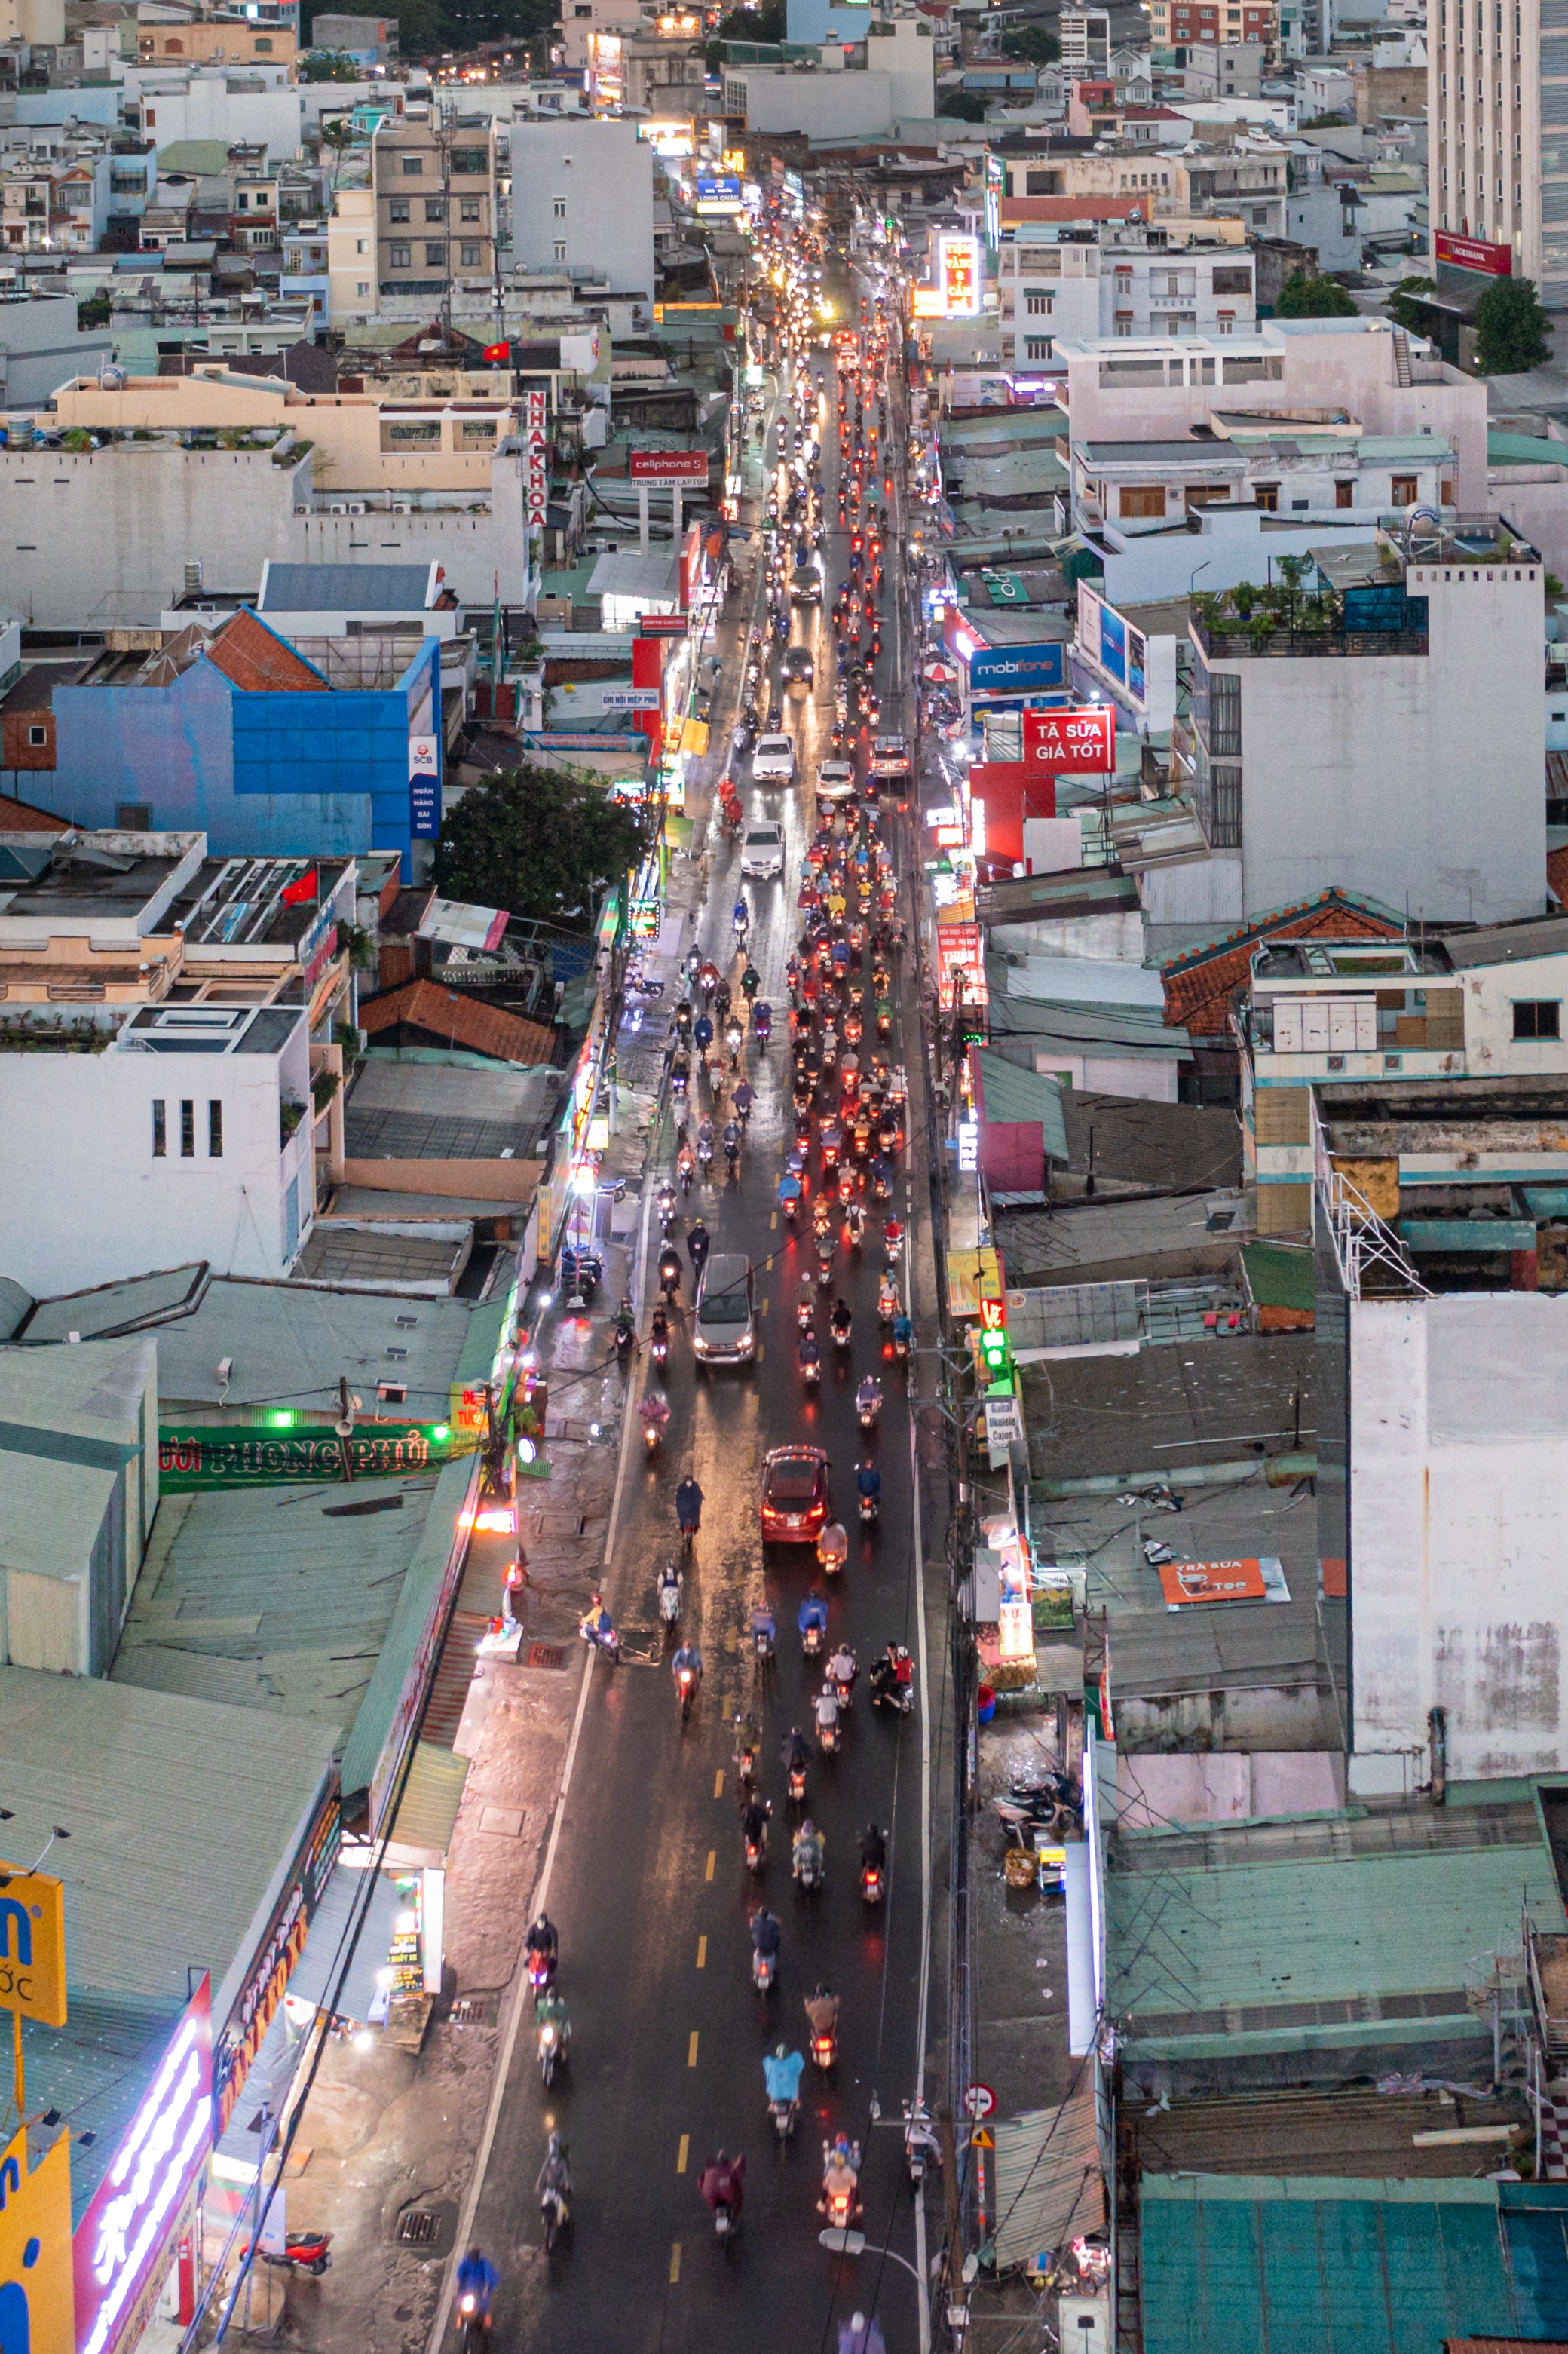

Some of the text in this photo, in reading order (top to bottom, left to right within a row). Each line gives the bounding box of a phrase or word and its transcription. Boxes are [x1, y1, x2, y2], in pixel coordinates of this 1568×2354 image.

[945, 256, 972, 269] VÀNG
[955, 270, 965, 280] &
[660, 477, 675, 486] TÂM
[677, 478, 707, 486] LAPTOP
[978, 659, 1053, 676] mobifone
[603, 695, 614, 703] CHI
[1037, 720, 1102, 738] TÃ SỮA
[1036, 739, 1104, 759] GIÁ TỐT
[950, 1271, 979, 1301] IN
[991, 1404, 1012, 1413] Guitar
[989, 1417, 1016, 1427] Ukulele
[992, 1431, 1014, 1441] Cajon
[1176, 1560, 1242, 1572] TRÀ SỮA
